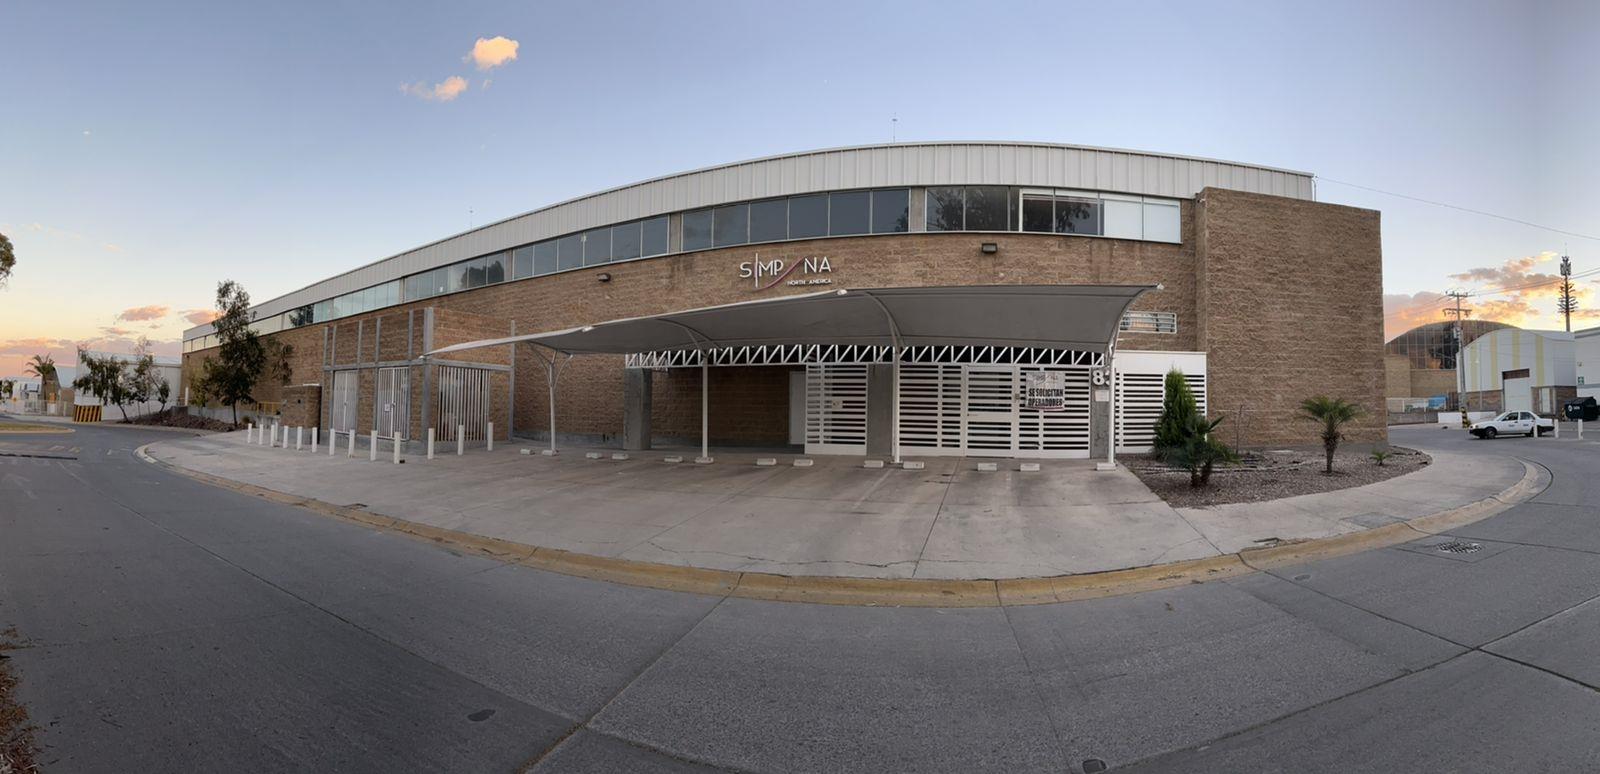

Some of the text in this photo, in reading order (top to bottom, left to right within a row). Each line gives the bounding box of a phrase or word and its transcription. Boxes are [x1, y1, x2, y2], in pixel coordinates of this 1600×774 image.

[808, 278, 832, 286] AMERICA
[1028, 388, 1064, 397] SE SOLICITAN
[1028, 398, 1063, 407] OPERADORES
